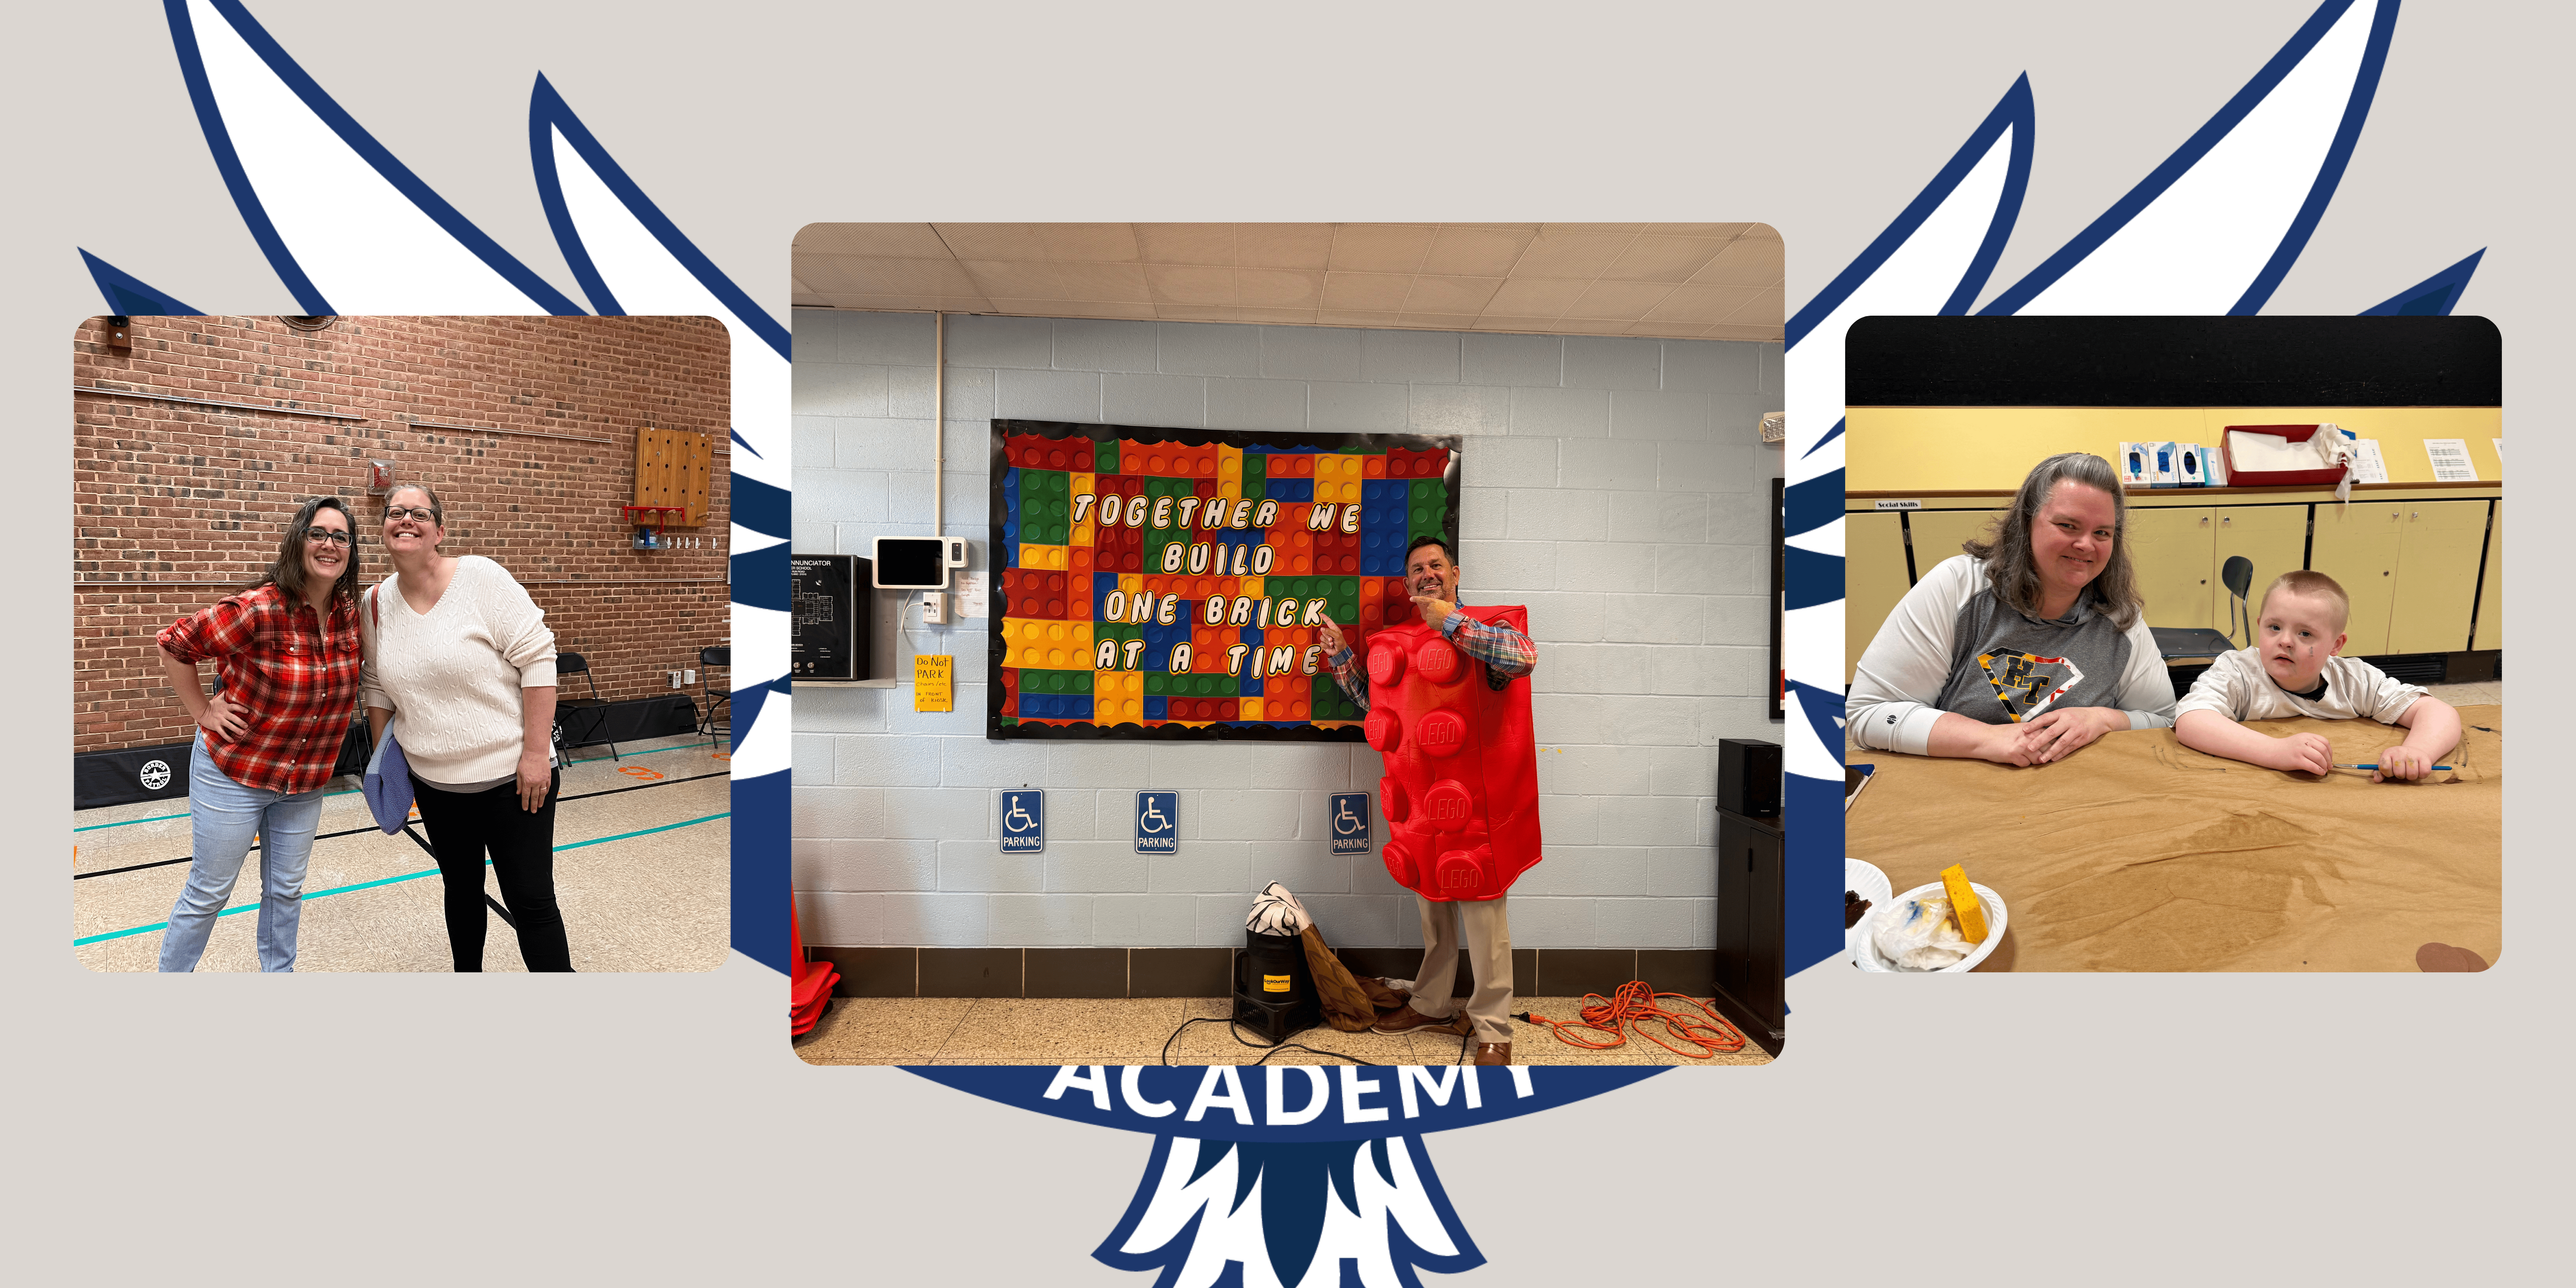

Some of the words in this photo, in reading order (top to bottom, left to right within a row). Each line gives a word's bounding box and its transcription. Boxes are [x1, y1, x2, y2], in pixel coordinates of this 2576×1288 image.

[1071, 492, 1279, 530] TOGETHER
[1307, 501, 1362, 534] WE
[1161, 542, 1275, 577] BUILD
[1104, 589, 1180, 626] ONE
[1205, 593, 1326, 629] BRICK
[931, 657, 949, 667] Not
[1093, 638, 1146, 671] AT
[1169, 641, 1193, 674] A
[1227, 643, 1322, 679] TIME
[1369, 651, 1389, 676] LEGO
[1418, 648, 1453, 672] LEGO
[917, 669, 944, 679] PARK
[2001, 656, 2051, 705] HT
[1365, 719, 1382, 740] LEGO
[1418, 721, 1456, 745] LEGO
[144, 763, 166, 773] BORDER
[145, 776, 167, 787] PATROL
[1429, 798, 1465, 821] LEGO
[1003, 836, 1040, 847] PARKING
[1138, 837, 1174, 848] PARKING
[1333, 838, 1368, 848] PARKING
[1383, 855, 1403, 879] LEGO
[1442, 869, 1479, 889] LEGO
